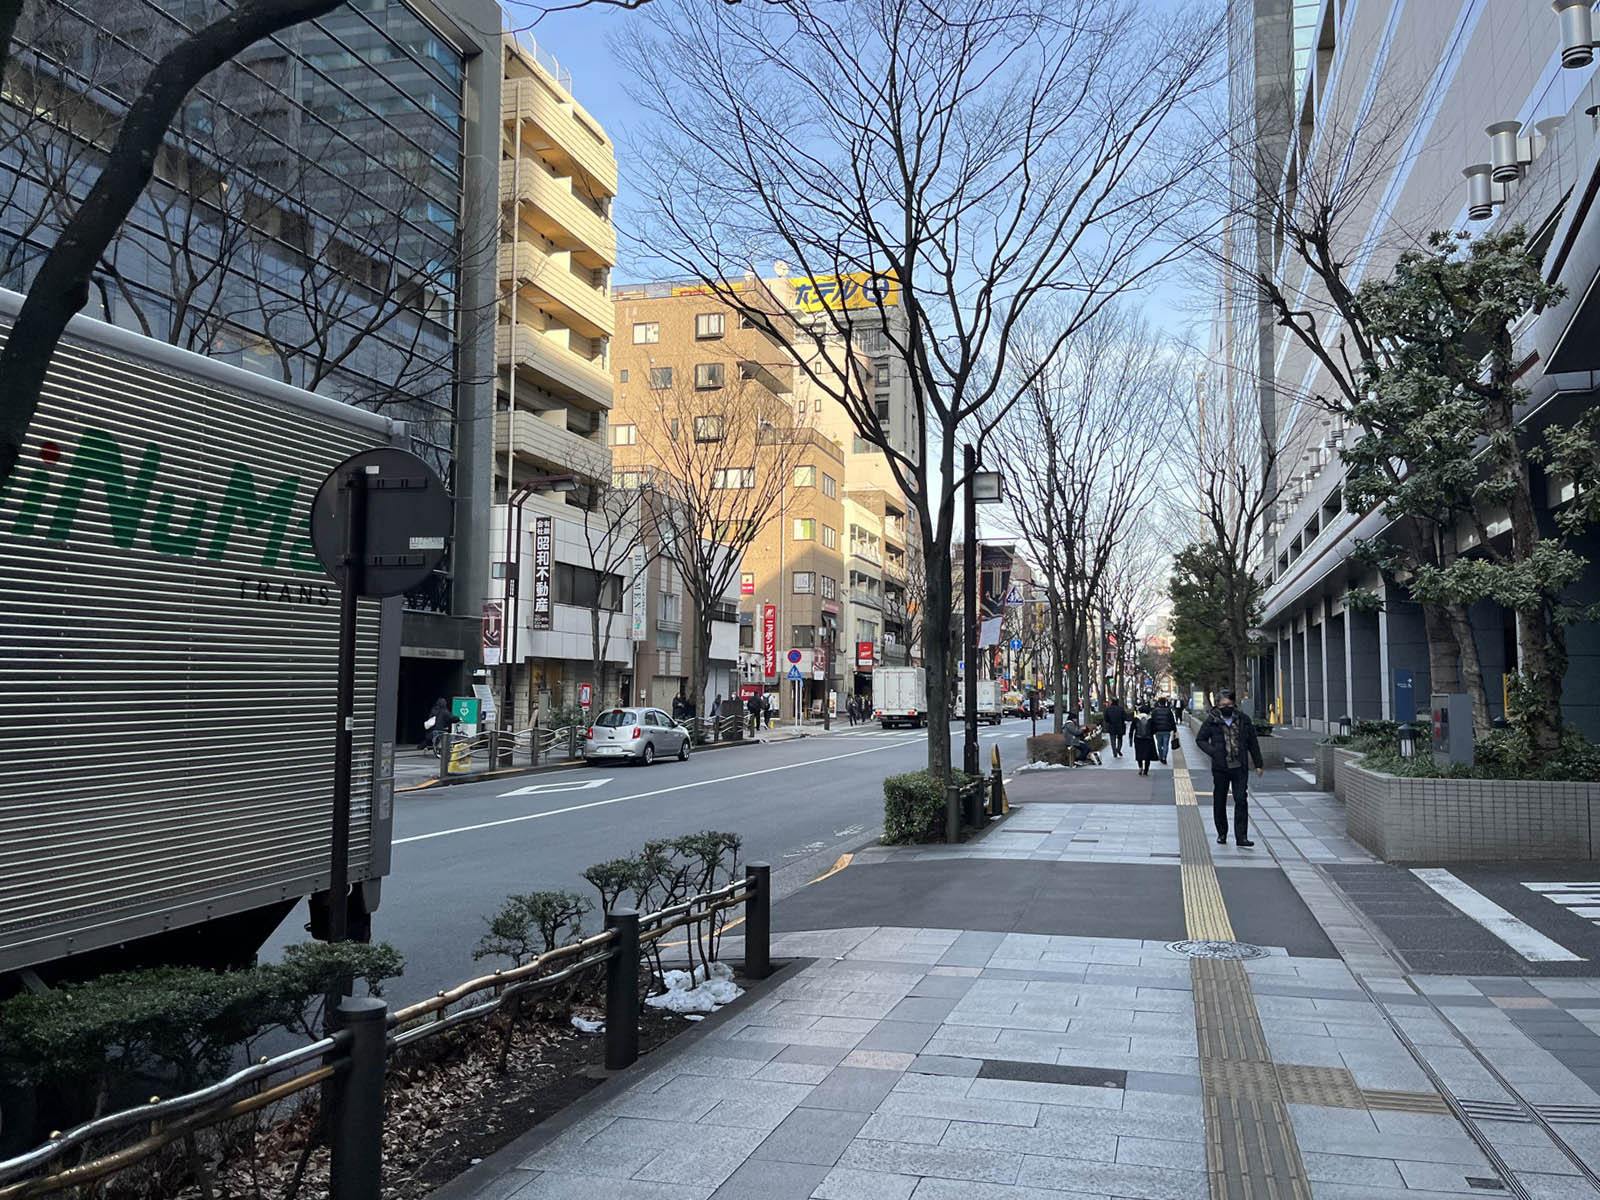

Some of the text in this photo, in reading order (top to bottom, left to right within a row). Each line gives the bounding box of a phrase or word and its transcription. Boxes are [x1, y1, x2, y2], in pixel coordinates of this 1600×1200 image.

[236, 577, 330, 606] TRANS
[535, 536, 550, 612] 昭和不動産
